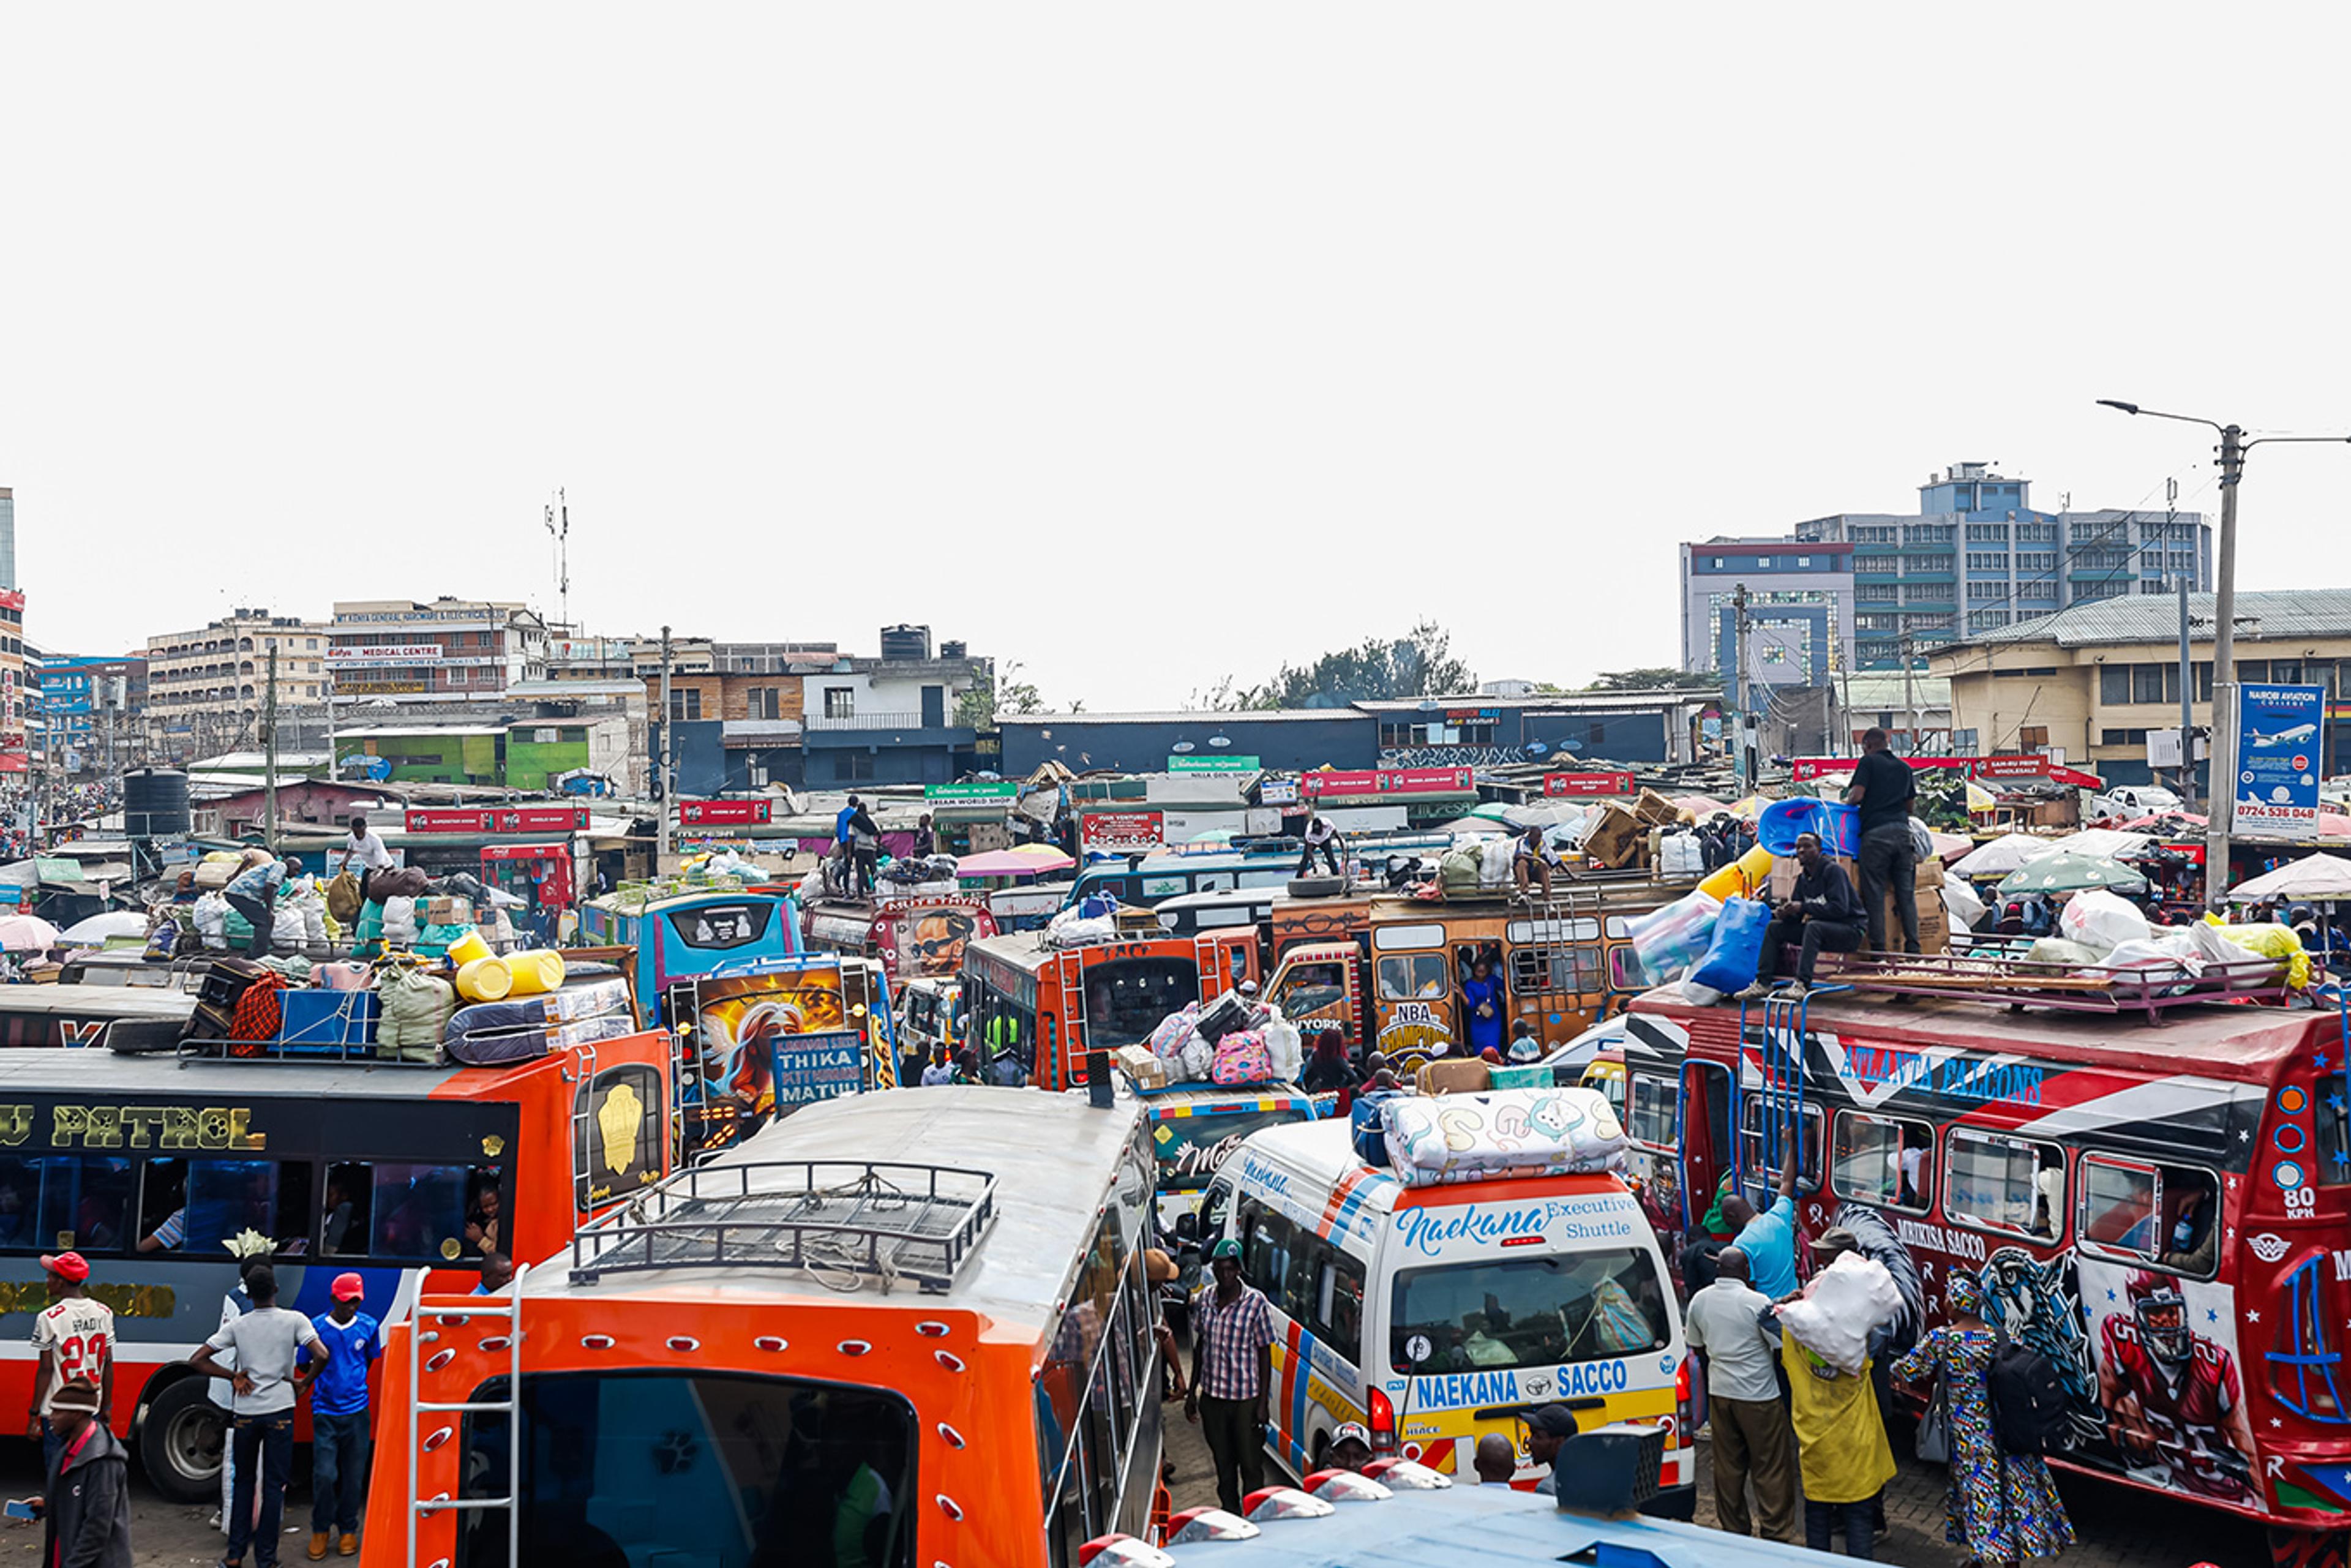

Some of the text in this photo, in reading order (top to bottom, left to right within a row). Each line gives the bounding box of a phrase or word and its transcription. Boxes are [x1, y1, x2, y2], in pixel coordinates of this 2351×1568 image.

[371, 612, 401, 622] GENERAL
[403, 611, 437, 621] HARDWARE
[362, 647, 400, 657] MEDICAL
[403, 646, 438, 656] CENTRE
[4, 672, 13, 727] HOTEL
[2249, 691, 2316, 702] NAIROBI AVIATION
[2238, 805, 2314, 819] 0724 536 048
[1398, 1005, 1431, 1021] NBA
[778, 1051, 852, 1069] THIKA
[1839, 1045, 2044, 1106] ATLANTA FALCONS
[51, 1106, 266, 1151] PATROL
[1545, 1196, 1637, 1218] Executive
[2283, 1187, 2315, 1208] 80
[1397, 1204, 1631, 1256] Naekana Shuttle
[1946, 1229, 1986, 1262] SACCO
[1417, 1359, 1628, 1408] NAEKANA SACCO
